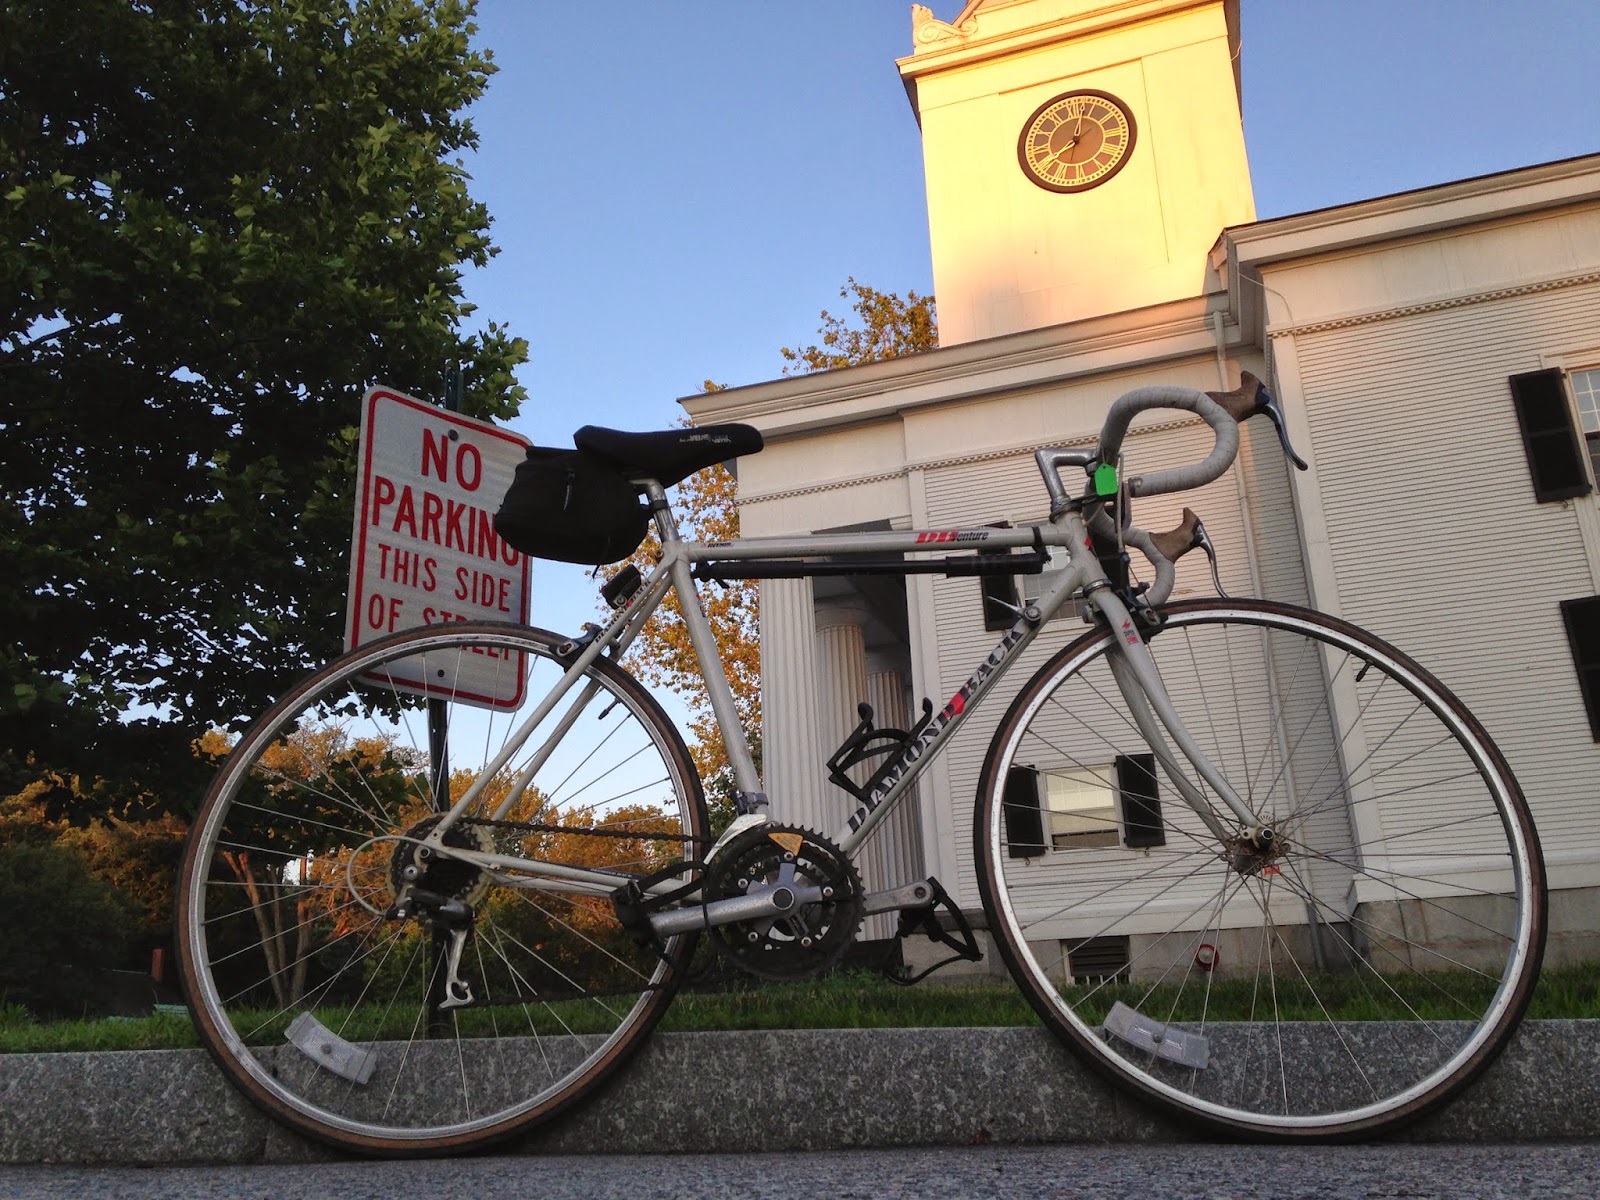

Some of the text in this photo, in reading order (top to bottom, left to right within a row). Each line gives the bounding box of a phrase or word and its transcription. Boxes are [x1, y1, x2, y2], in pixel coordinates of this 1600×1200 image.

[421, 428, 482, 491] NO
[378, 543, 511, 613] THIS SIDE
[368, 593, 403, 633] OF
[847, 631, 1024, 835] DIAMOND BACK
